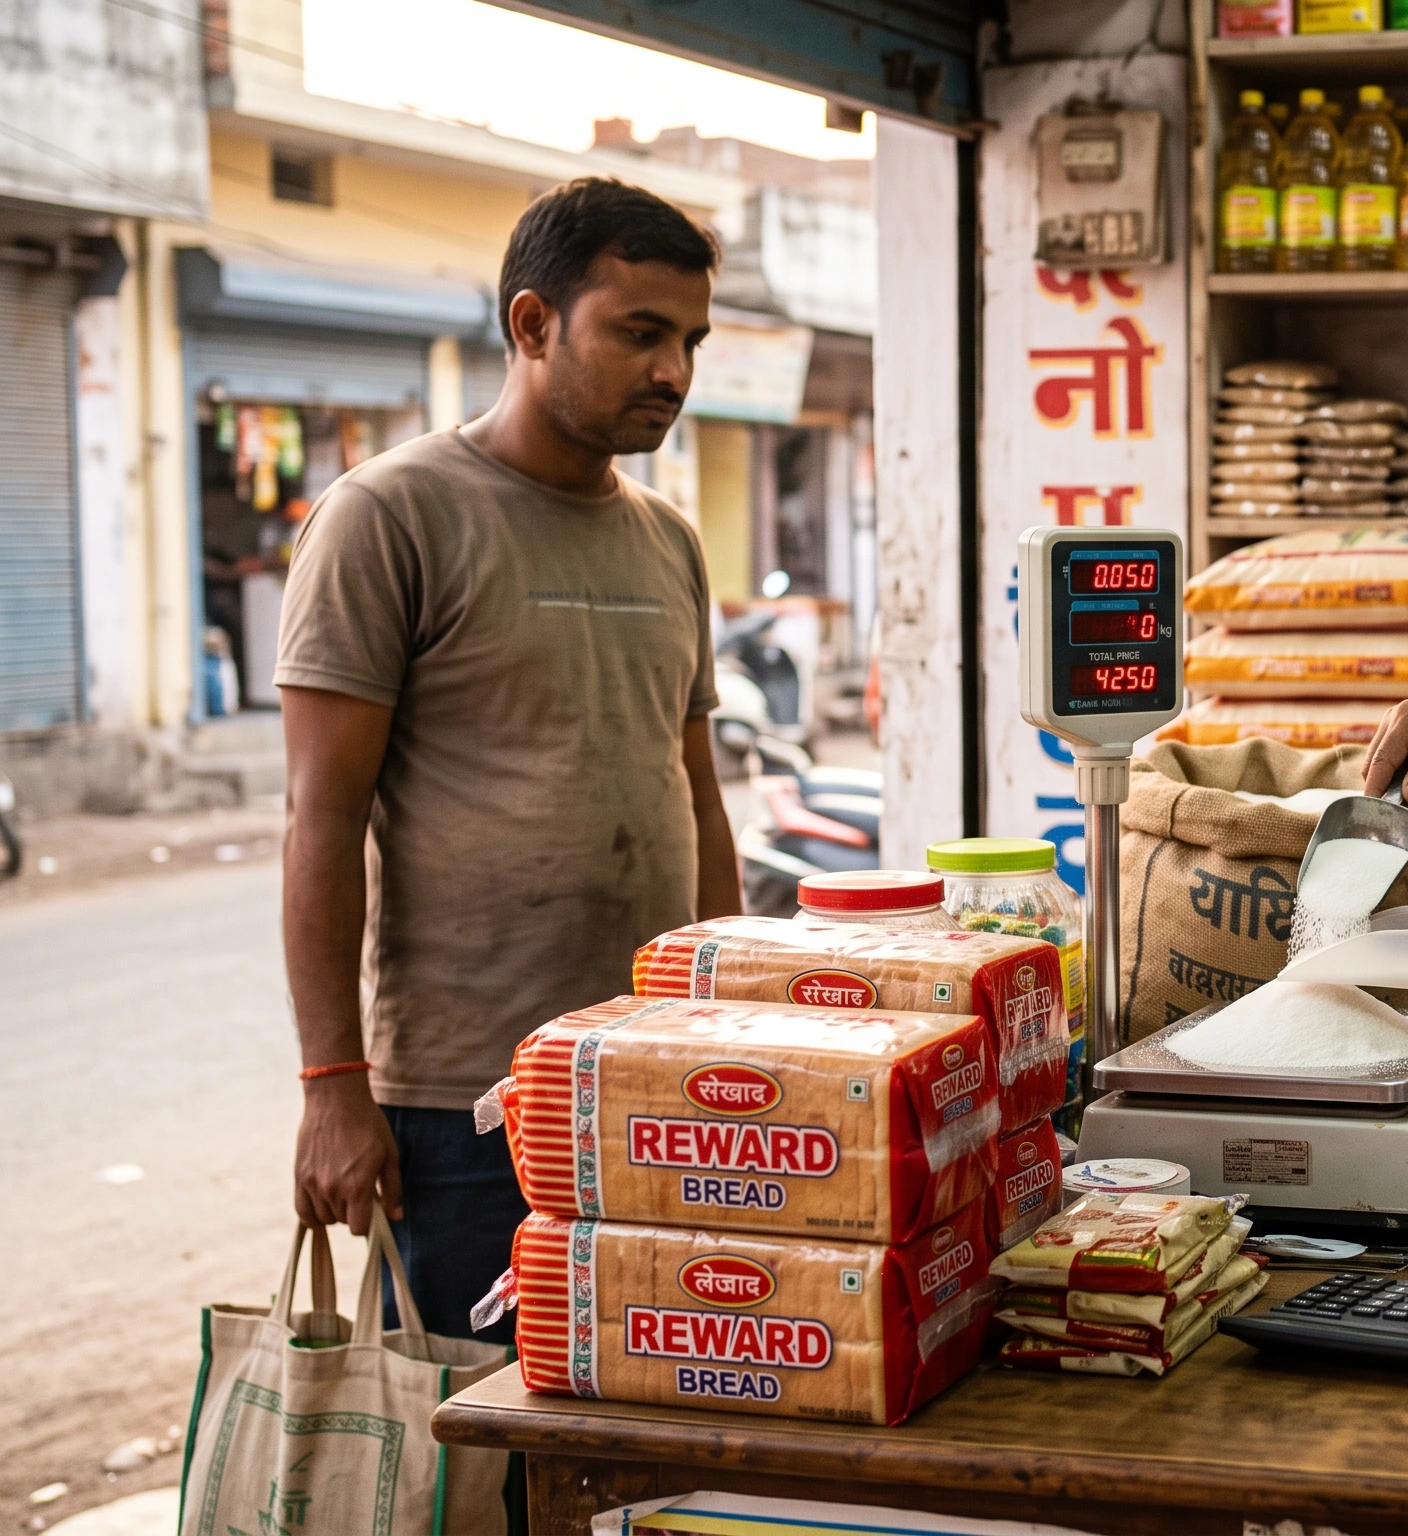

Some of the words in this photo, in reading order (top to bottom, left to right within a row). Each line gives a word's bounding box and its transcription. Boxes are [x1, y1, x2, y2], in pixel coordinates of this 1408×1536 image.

[1159, 624, 1172, 638] kg
[1088, 652, 1115, 661] TOTAL
[1096, 666, 1155, 690] 4250
[630, 1116, 837, 1177] REWARD
[682, 1175, 786, 1211] BREAD
[627, 1306, 832, 1369] REWARD
[677, 1366, 781, 1402] BREAD
